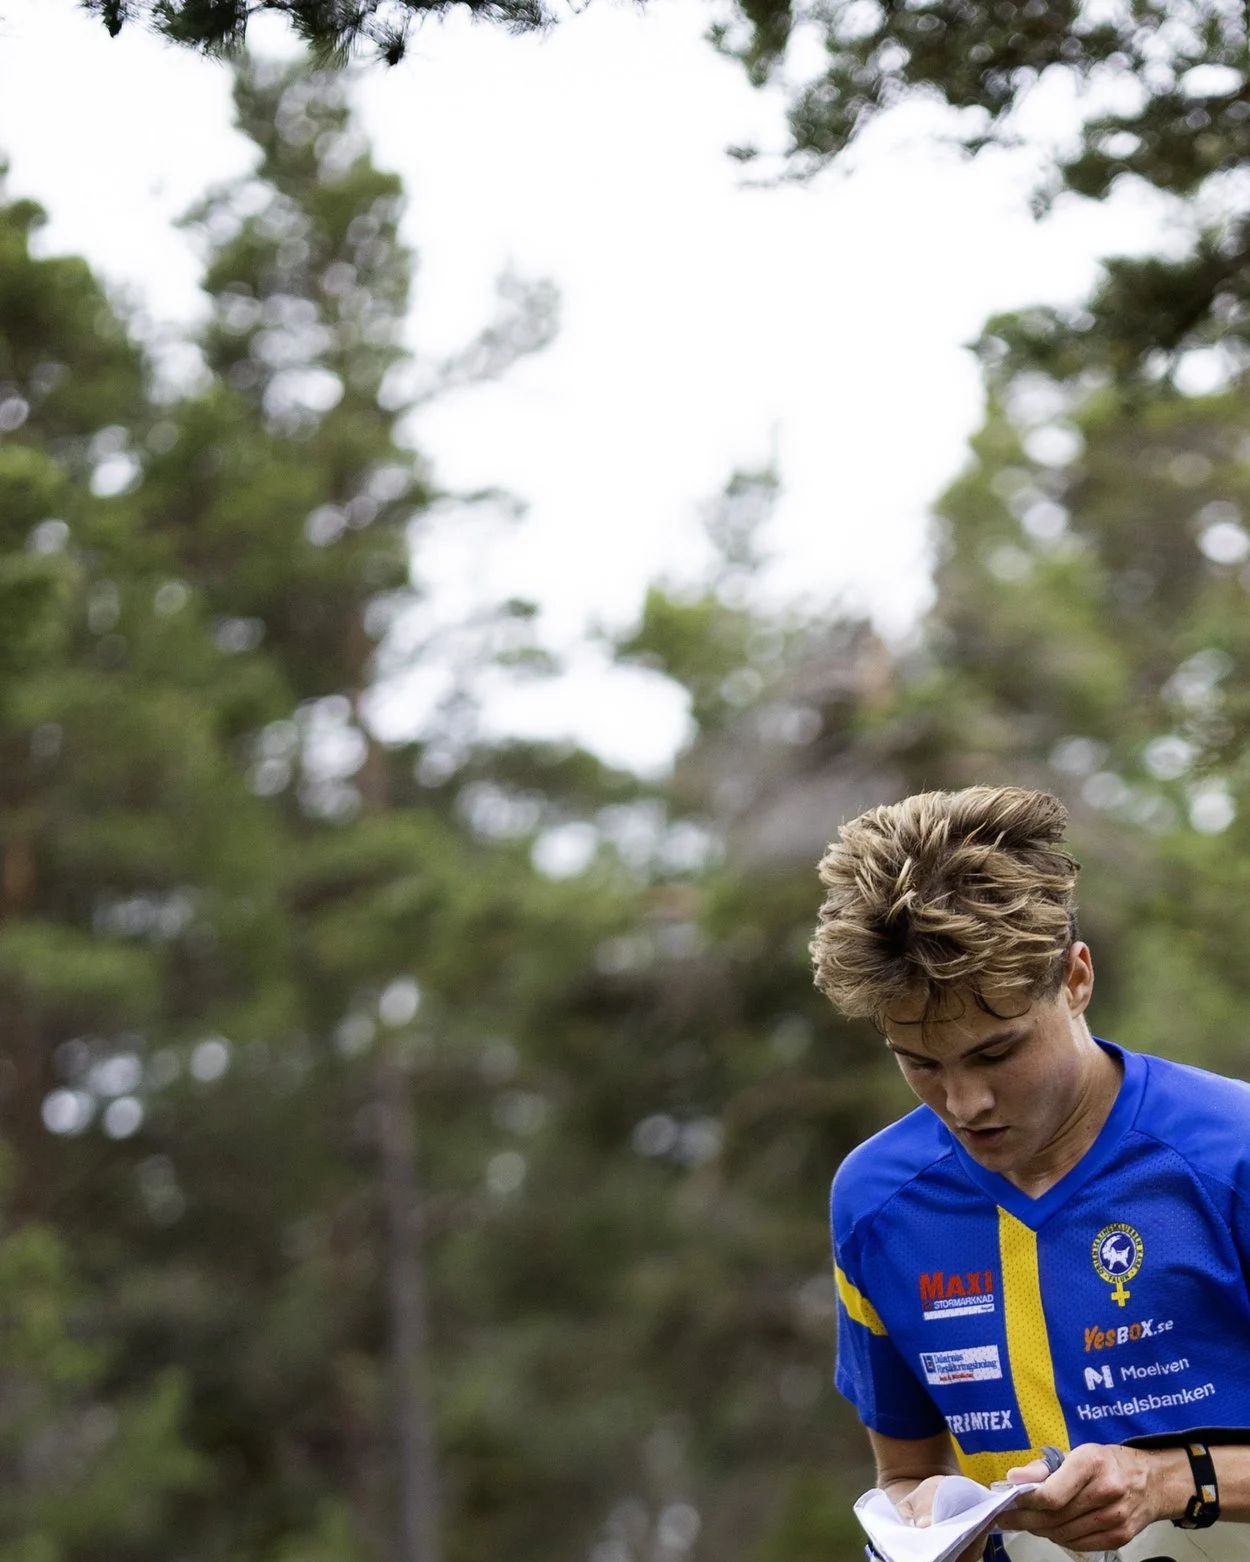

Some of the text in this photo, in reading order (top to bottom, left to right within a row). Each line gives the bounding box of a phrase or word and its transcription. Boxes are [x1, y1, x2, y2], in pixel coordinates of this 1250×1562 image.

[919, 1270, 994, 1301] MAXI
[934, 1294, 994, 1310] STORMARKNAD
[1120, 1357, 1190, 1382] Moelven
[1077, 1382, 1216, 1421] Handelsbanken
[945, 1410, 1013, 1434] TRIMTEX
